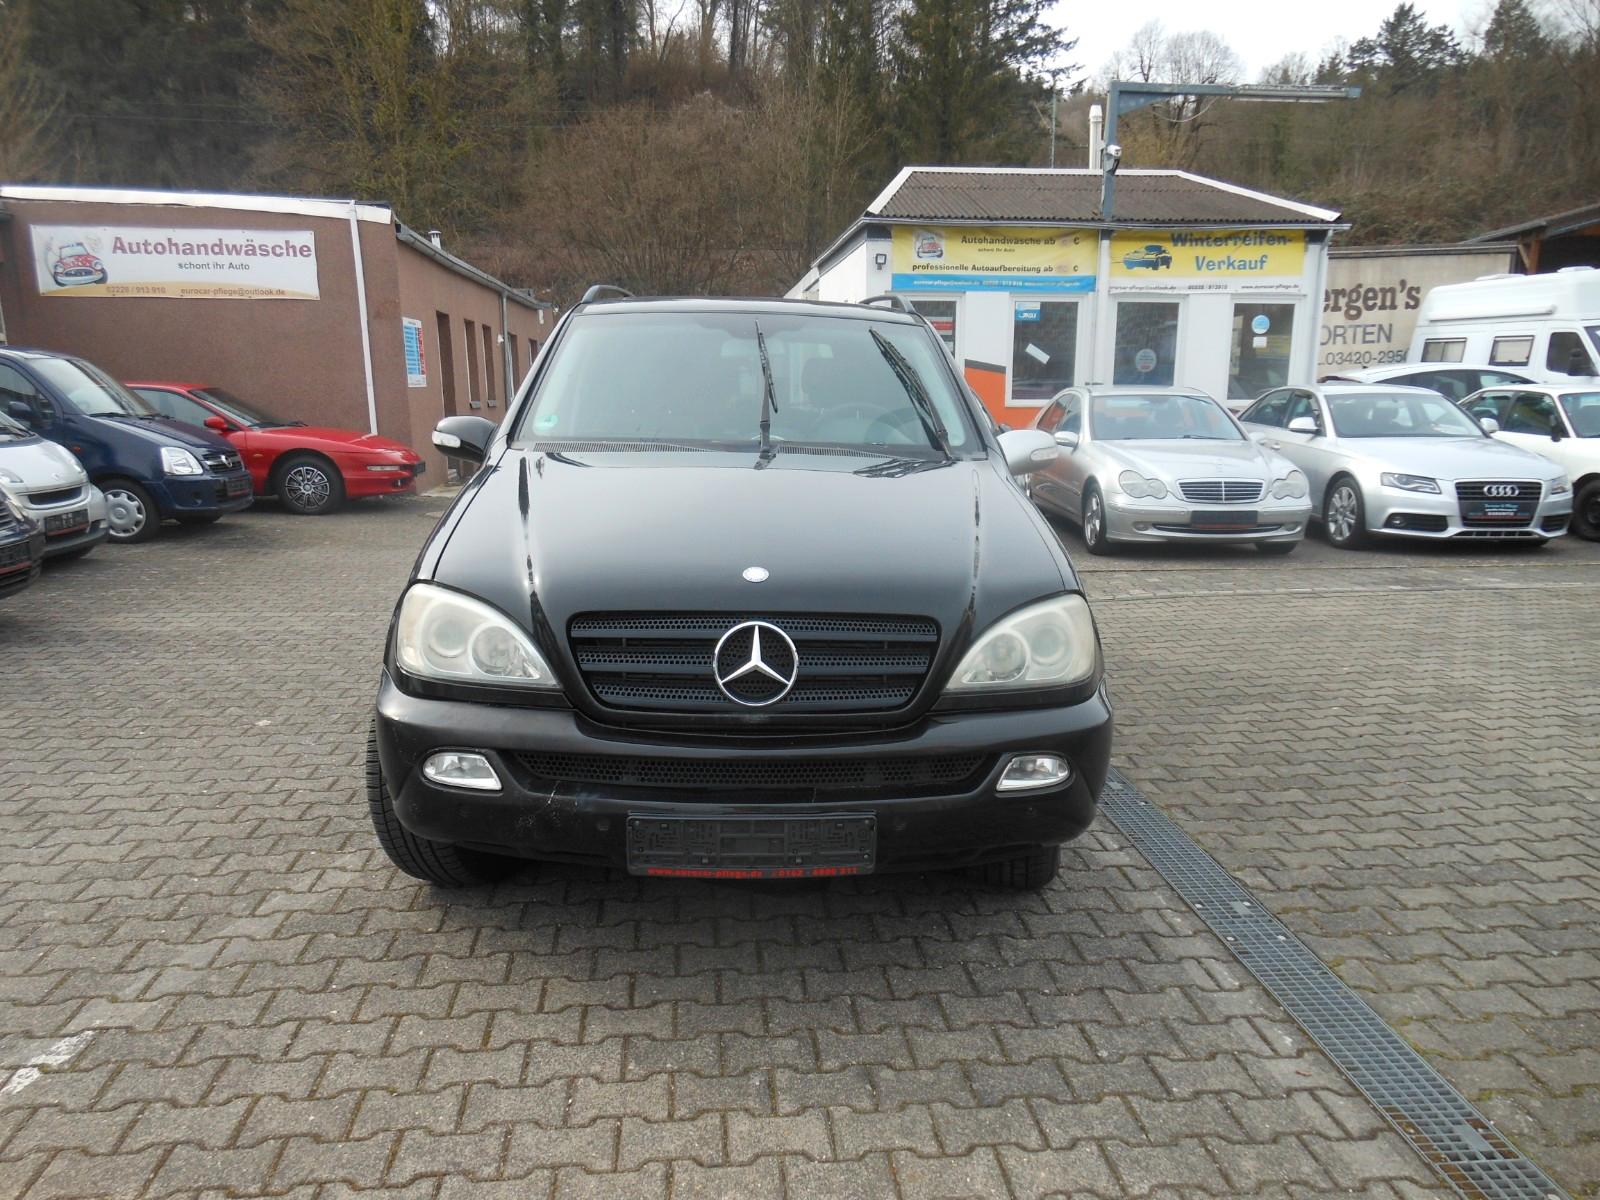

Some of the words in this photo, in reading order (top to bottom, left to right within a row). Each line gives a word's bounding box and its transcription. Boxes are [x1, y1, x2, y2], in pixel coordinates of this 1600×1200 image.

[1044, 237, 1056, 245] ab
[1171, 231, 1294, 247] Winterreifen-
[112, 236, 313, 258] Autohandwäsche
[228, 262, 250, 271] Auto
[912, 263, 969, 272] professionelle
[971, 264, 1041, 274] Autoaufbereitung
[1043, 265, 1054, 273] ab
[1195, 255, 1268, 271] Verkauf
